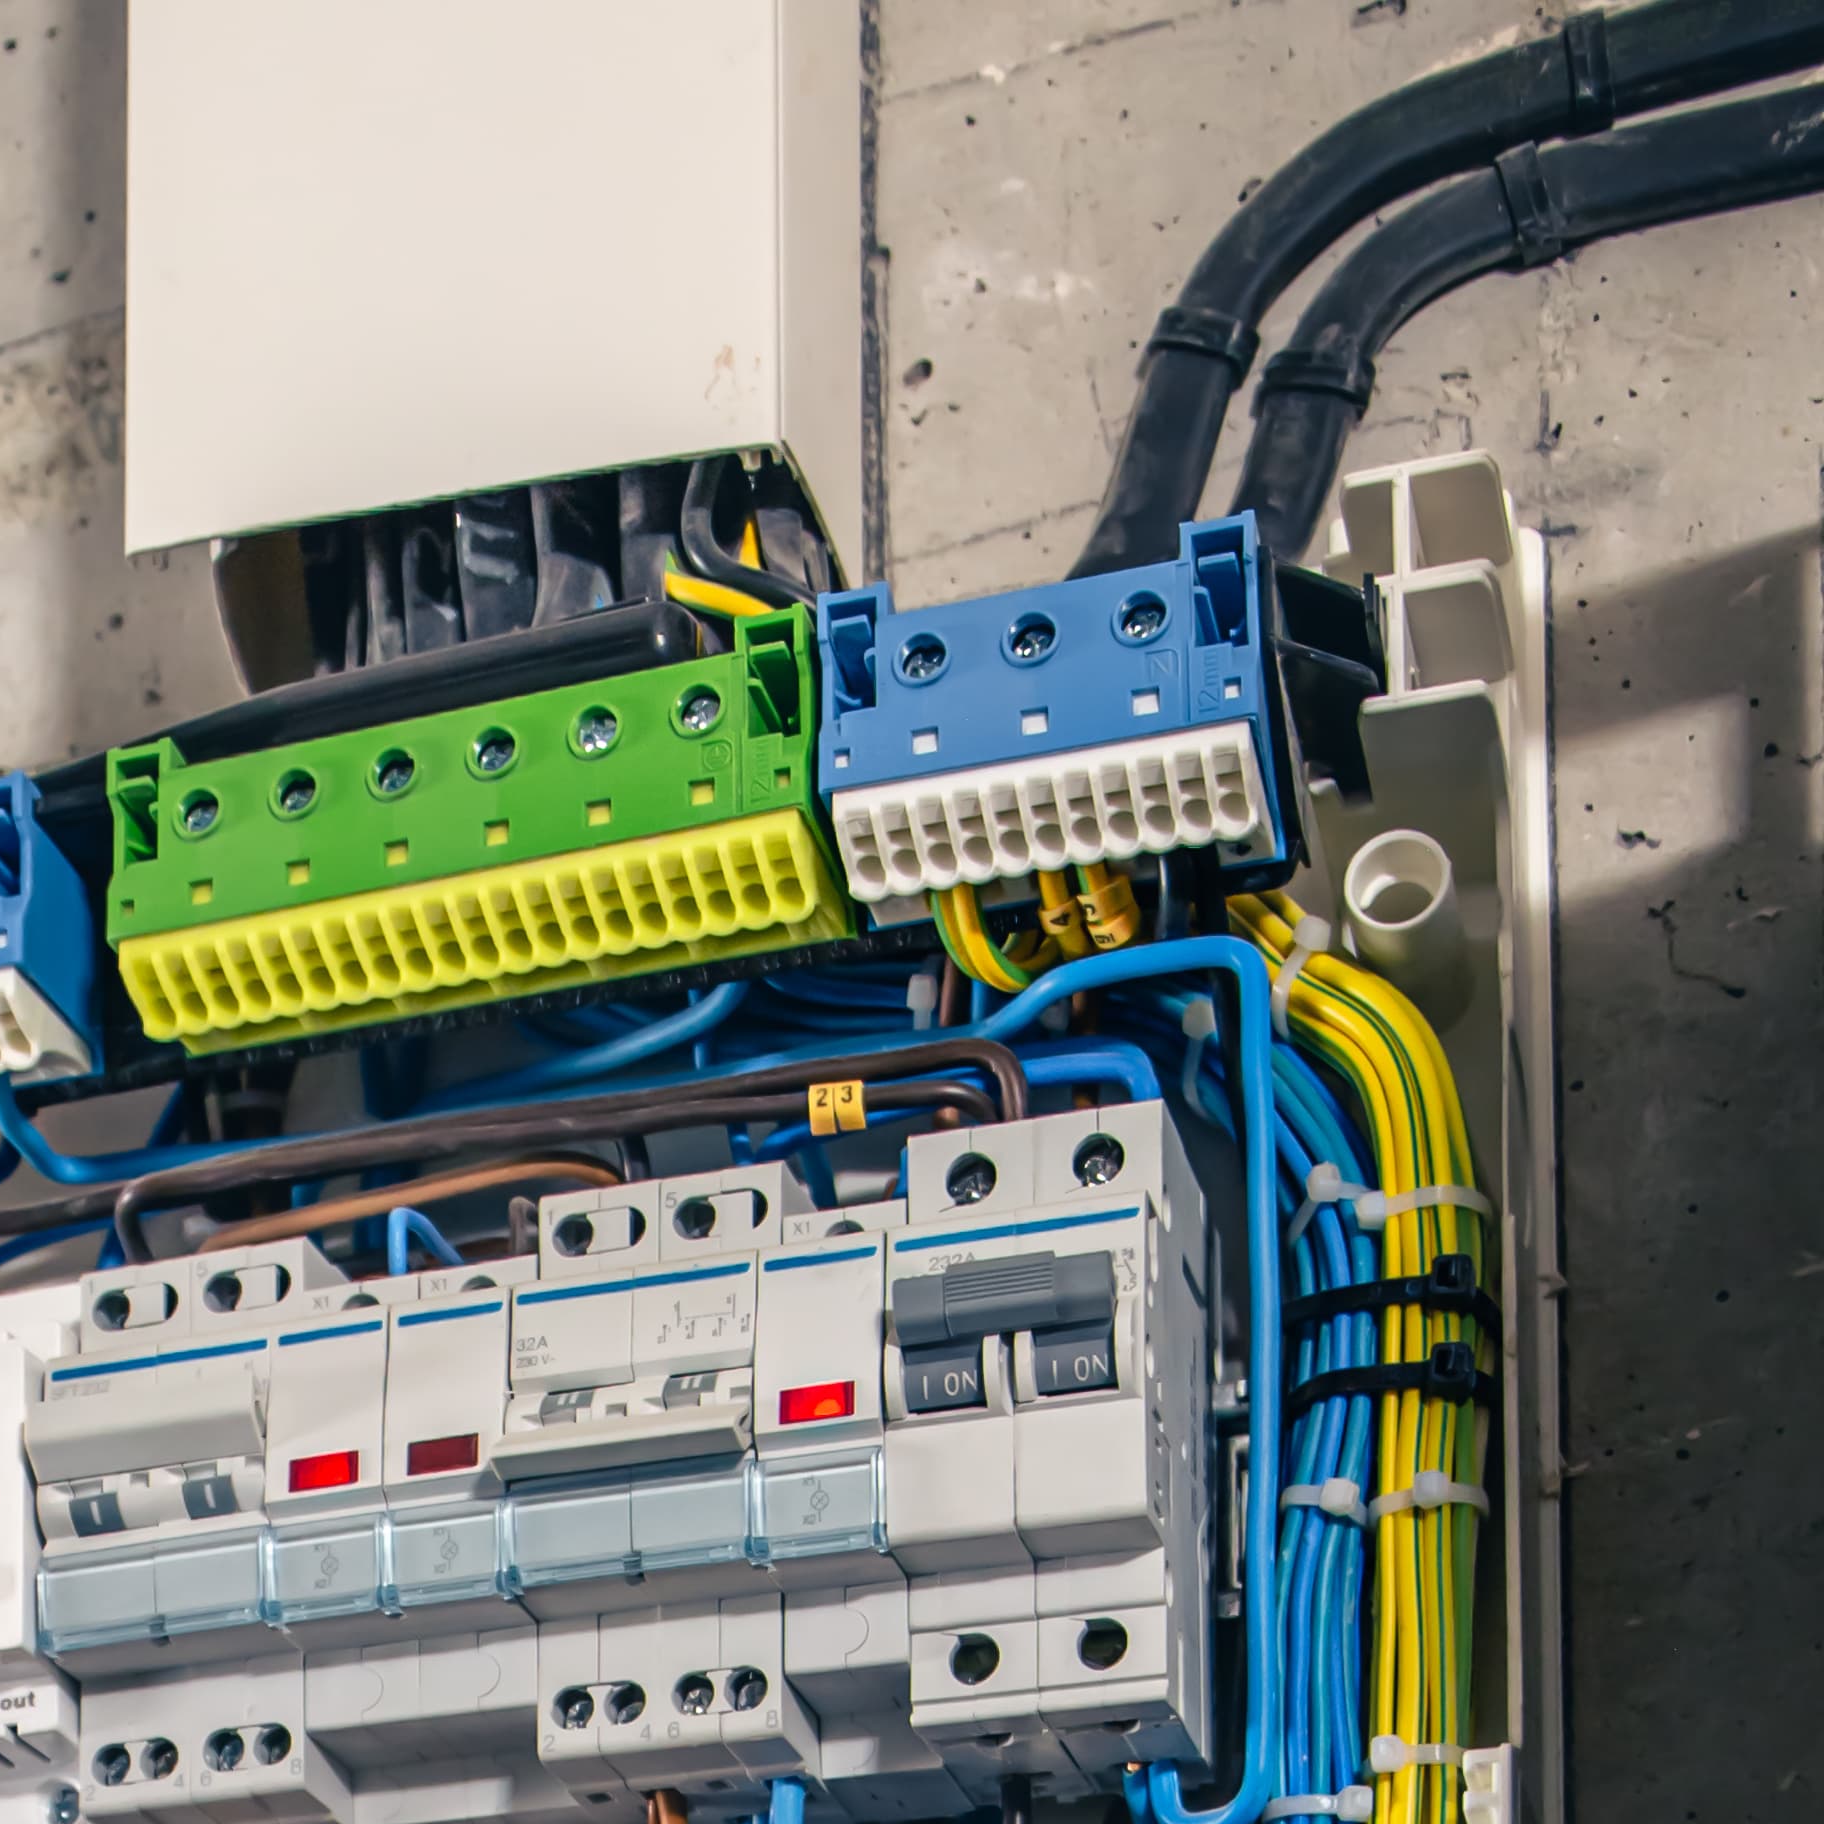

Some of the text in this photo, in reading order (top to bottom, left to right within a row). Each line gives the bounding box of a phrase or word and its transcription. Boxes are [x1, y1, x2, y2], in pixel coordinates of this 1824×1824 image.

[516, 1335, 548, 1353] 32A
[1075, 1354, 1109, 1382] ON
[943, 1369, 977, 1396] ON
[0, 1690, 36, 1711] out
[640, 1724, 652, 1741] 4
[542, 1734, 555, 1753] 2
